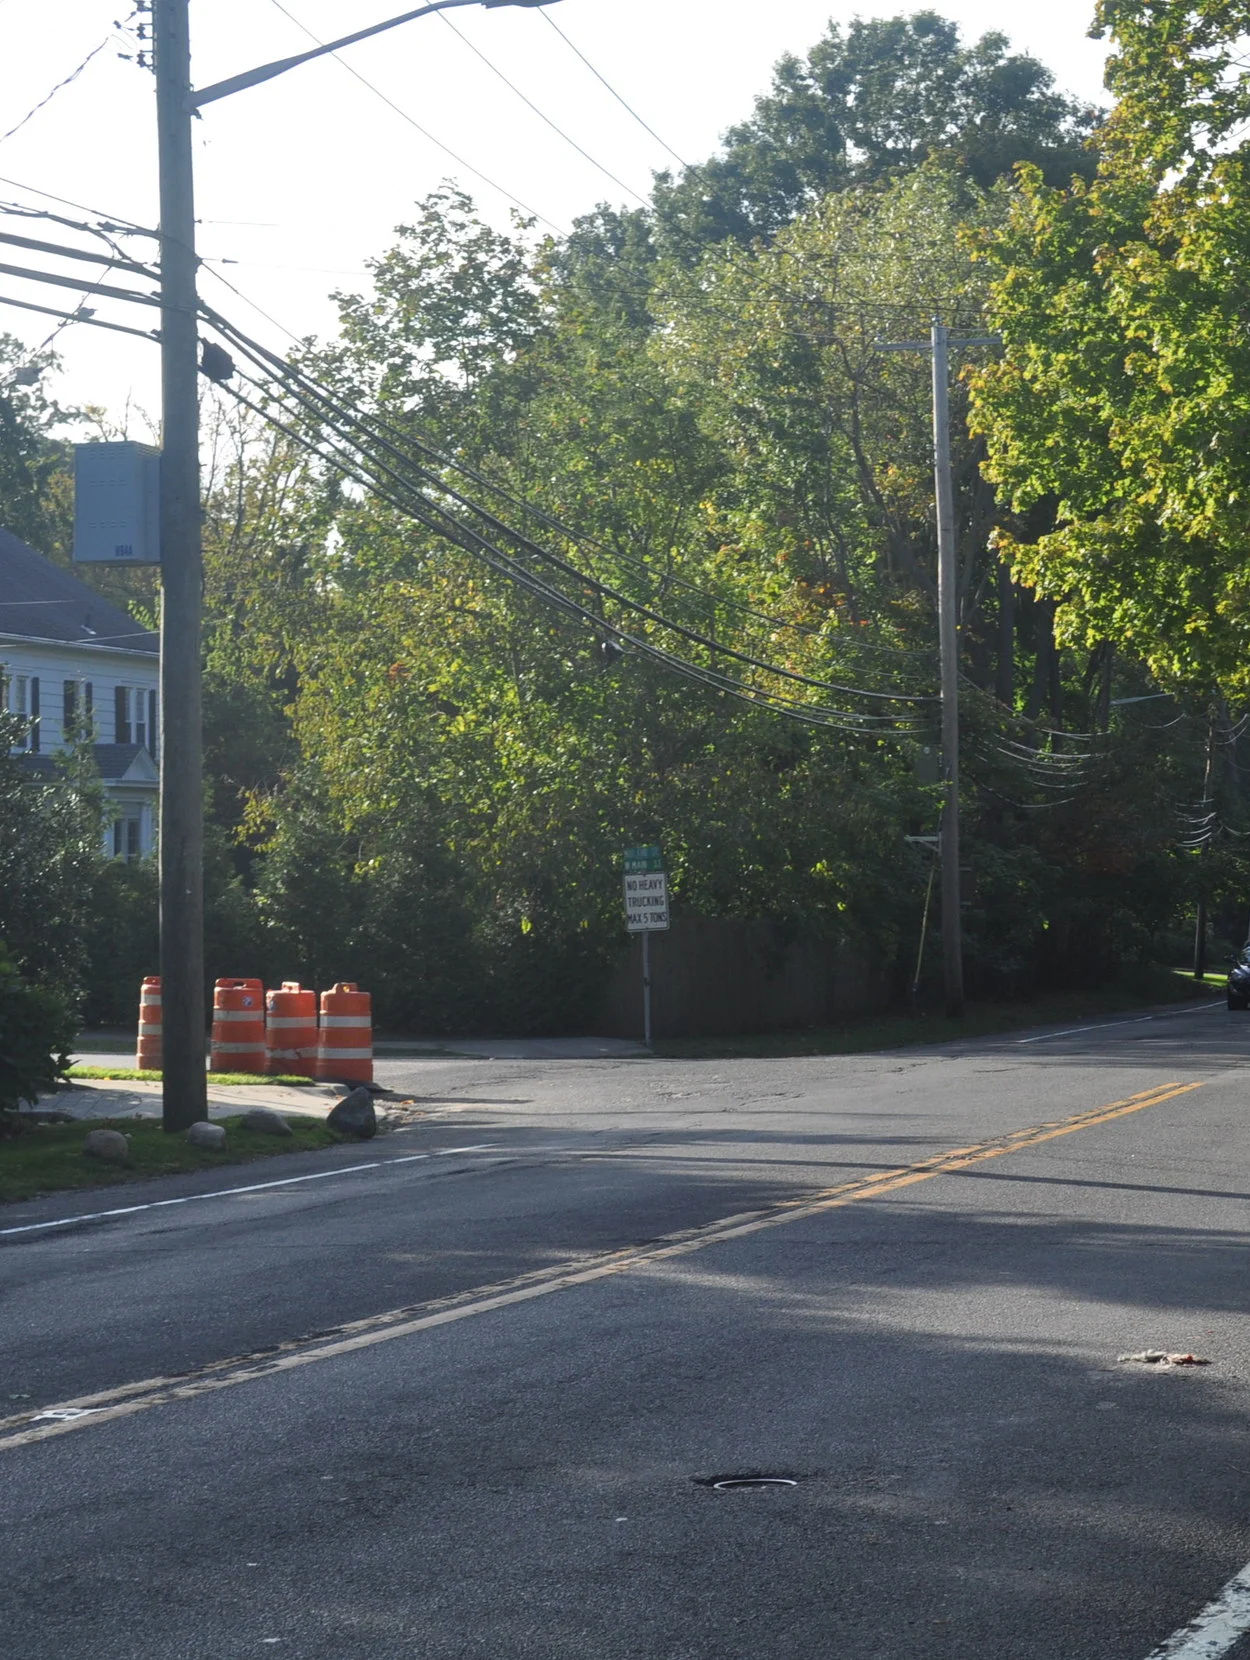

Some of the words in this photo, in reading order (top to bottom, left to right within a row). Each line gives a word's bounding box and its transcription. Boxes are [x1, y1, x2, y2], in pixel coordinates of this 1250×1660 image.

[627, 880, 638, 891] NO
[639, 879, 664, 890] HEAVY
[628, 895, 665, 908] TRUCKING
[627, 913, 642, 924] MAX
[643, 912, 649, 924] 5
[650, 911, 668, 923] TONS
